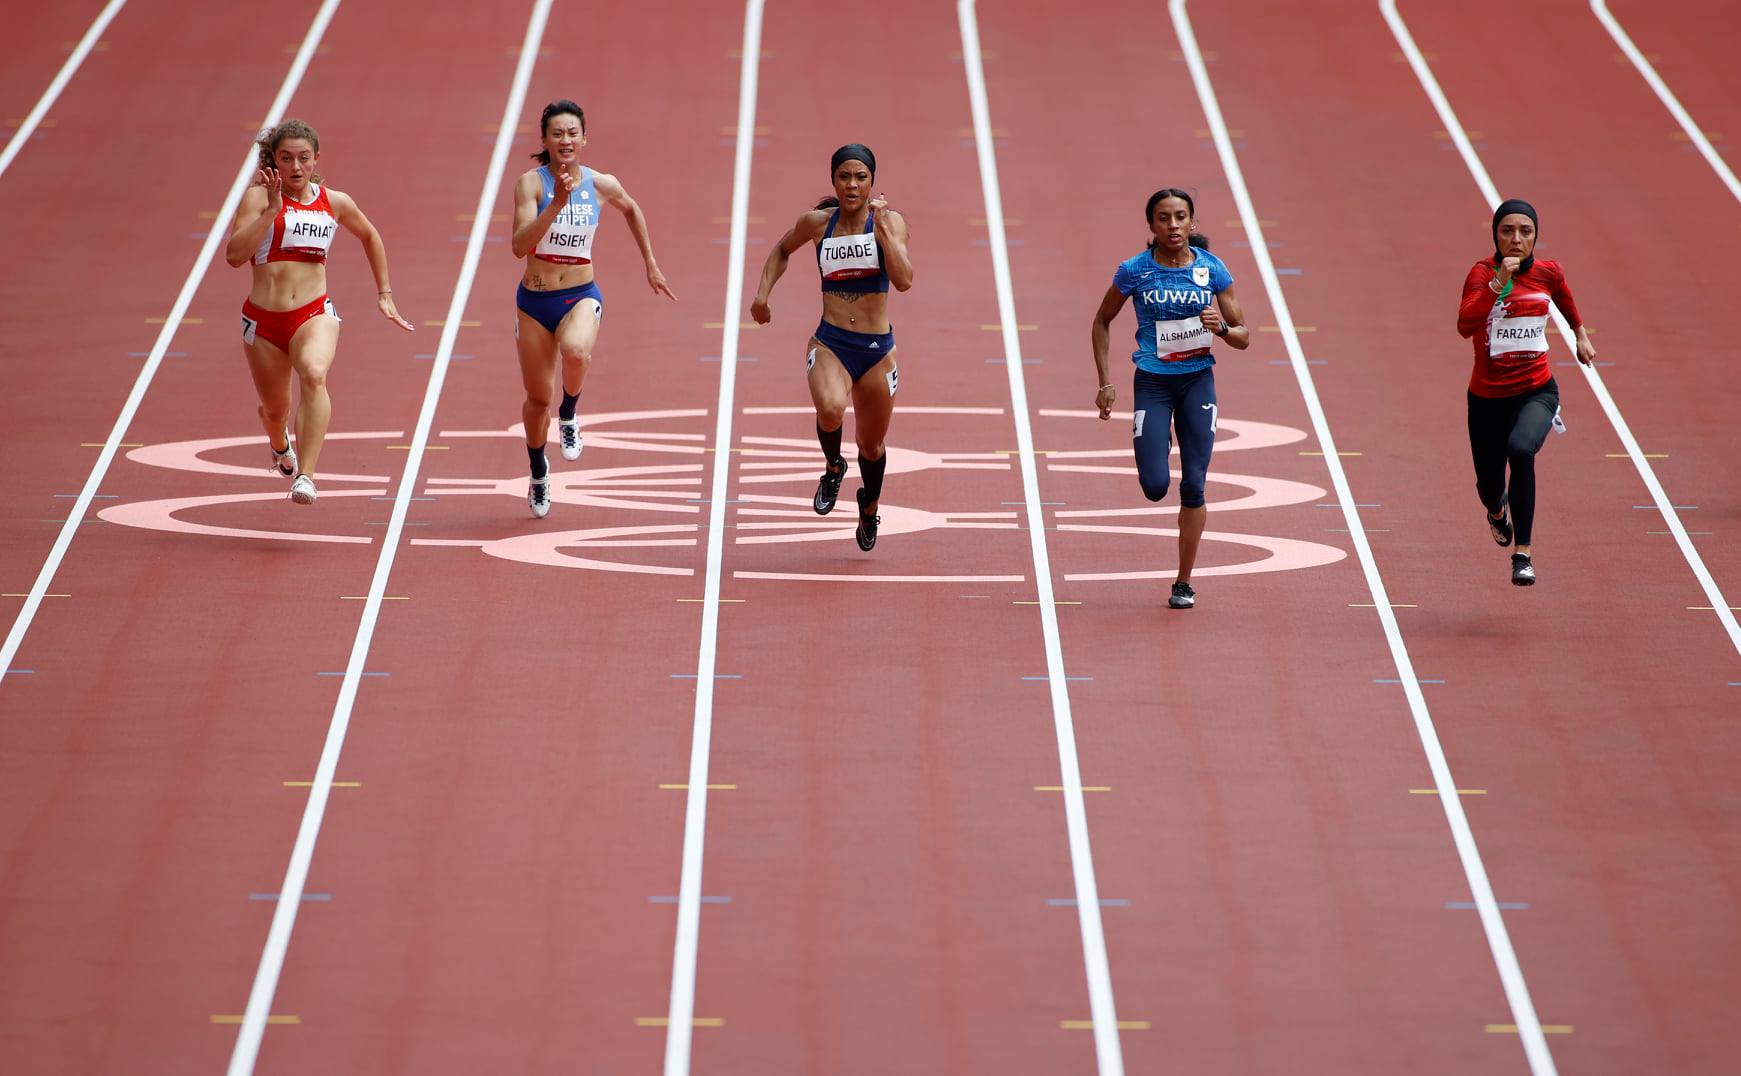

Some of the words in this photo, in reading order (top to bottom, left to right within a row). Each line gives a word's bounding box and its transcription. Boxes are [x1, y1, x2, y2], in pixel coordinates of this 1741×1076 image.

[556, 214, 589, 226] TAIPEI
[549, 232, 587, 248] HSIEH
[824, 243, 873, 262] TUGADE
[1143, 290, 1212, 305] KUWAIT
[241, 316, 252, 337] 7
